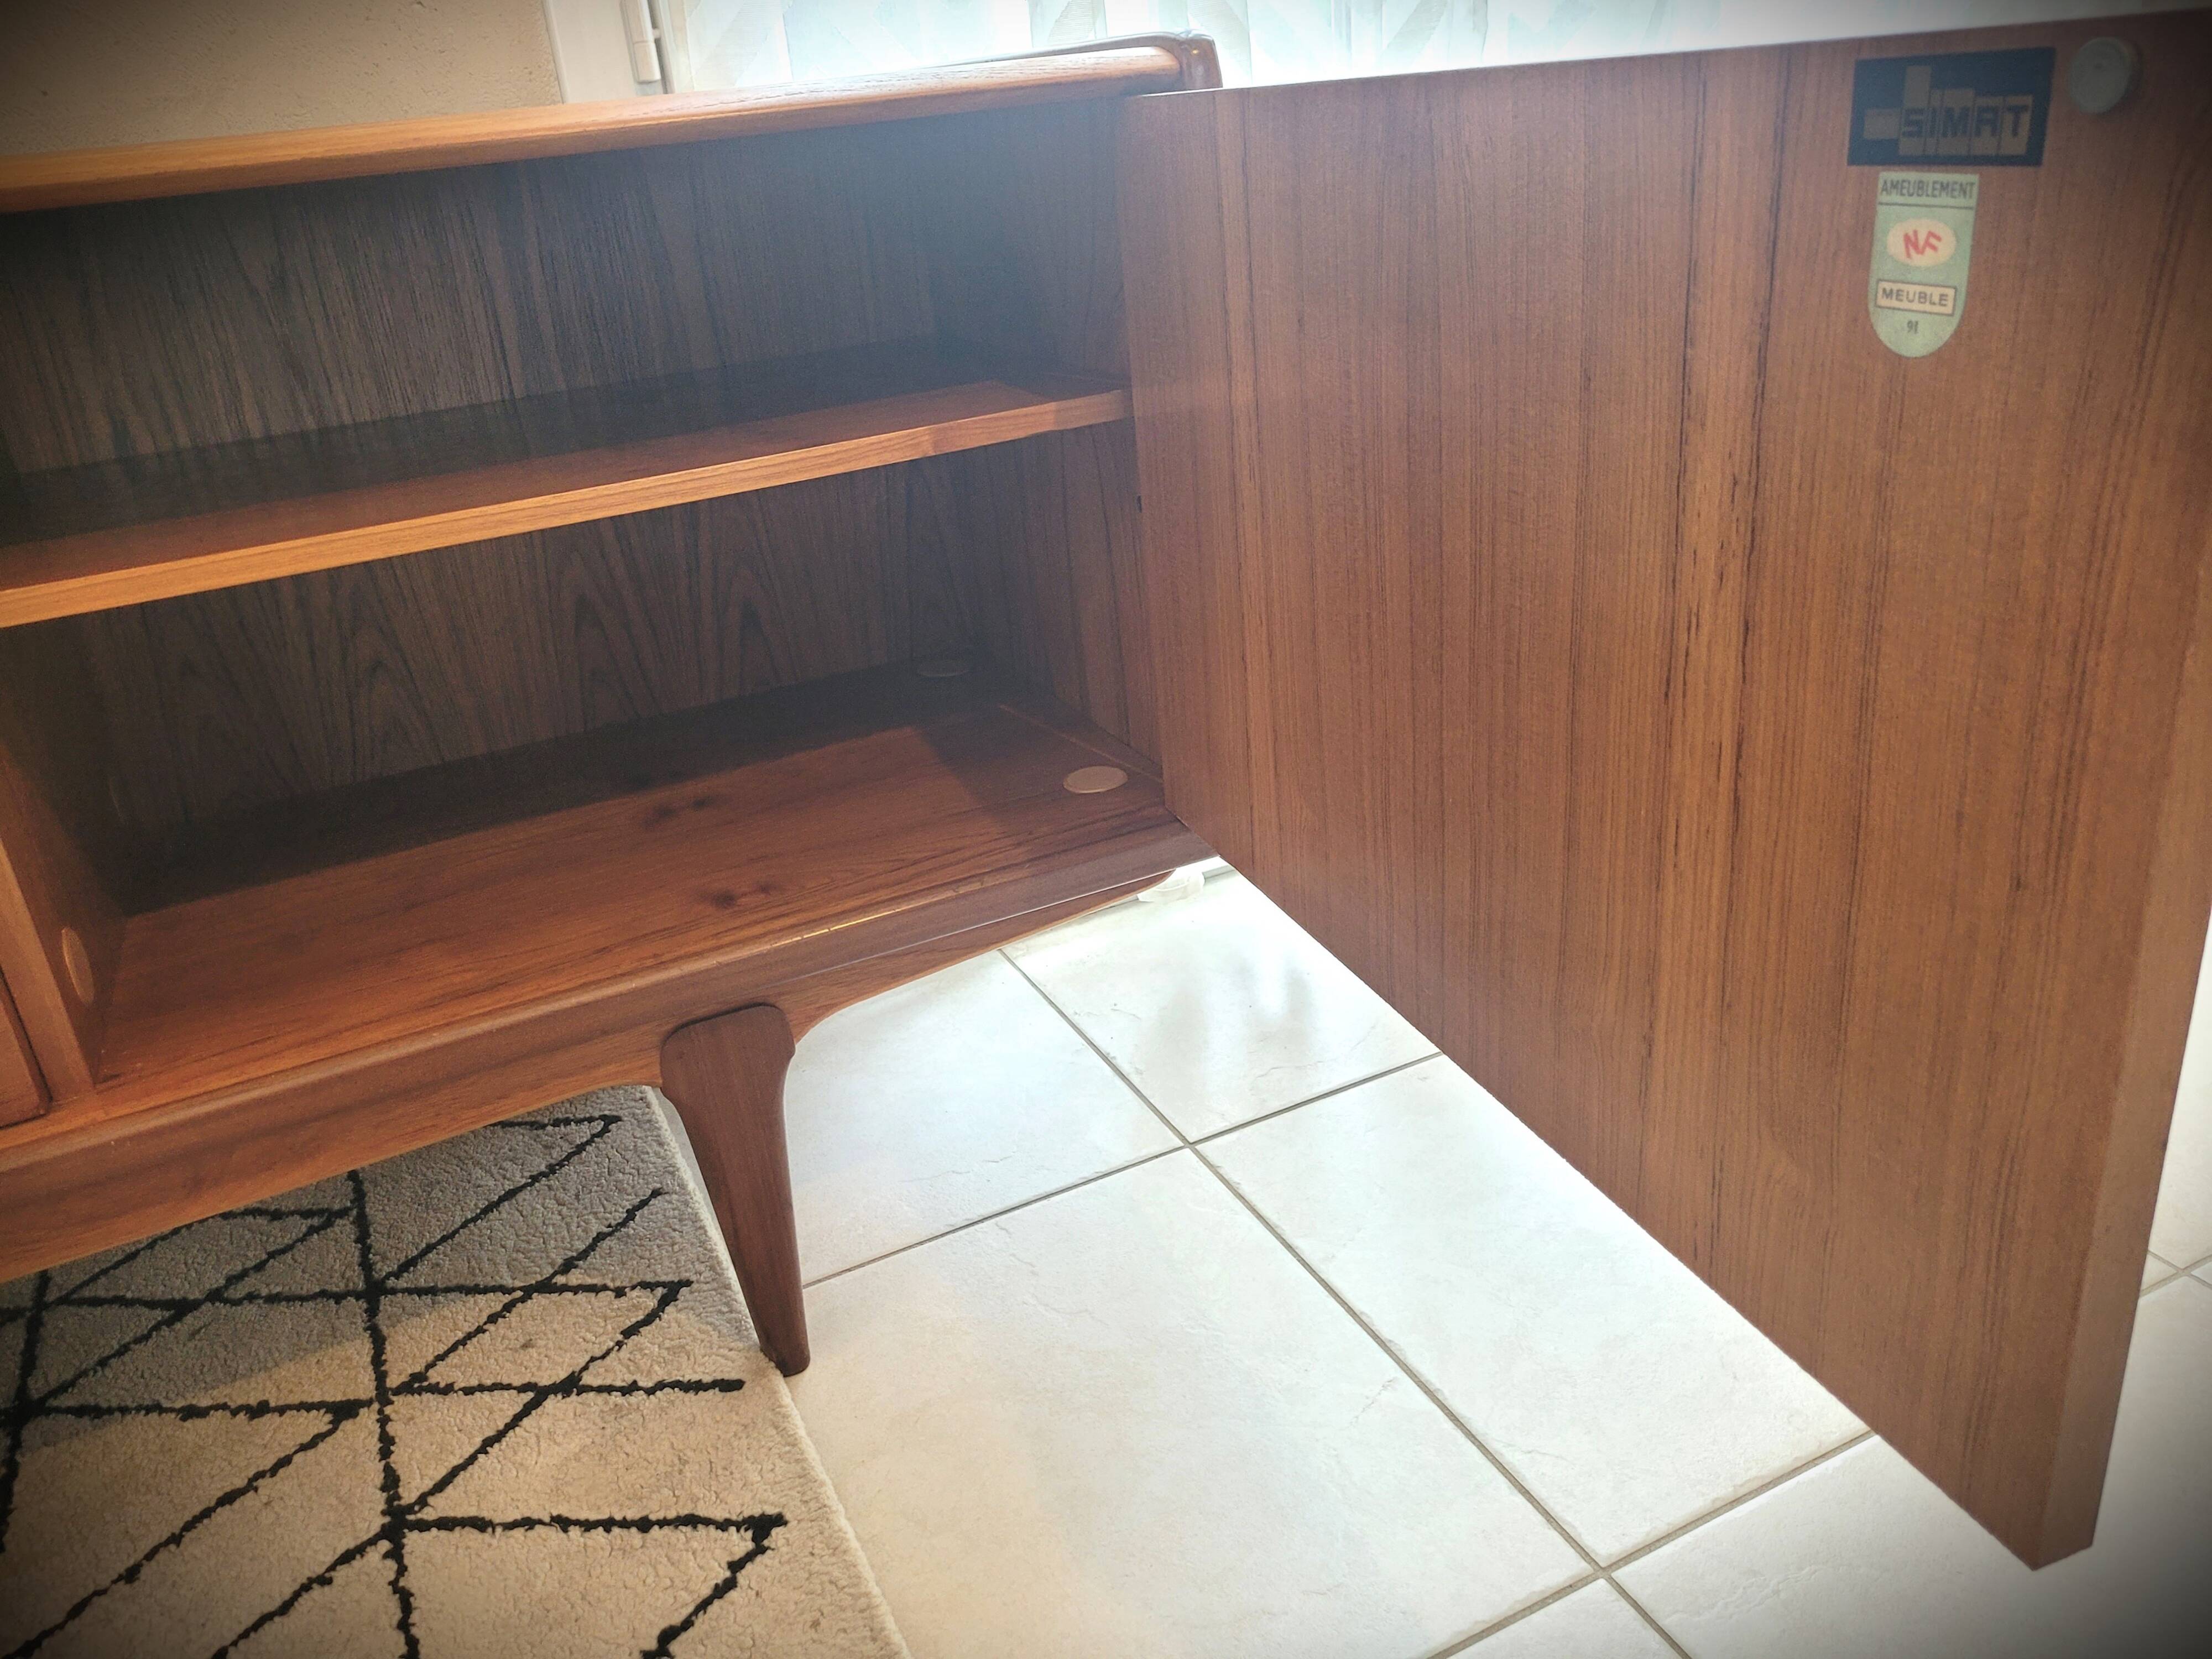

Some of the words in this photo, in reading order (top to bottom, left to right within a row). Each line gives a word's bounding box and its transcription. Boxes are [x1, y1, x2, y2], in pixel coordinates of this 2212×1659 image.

[1901, 104, 2030, 138] SIMAT
[1881, 179, 1976, 199] AMEUBLEMENT
[1903, 229, 1943, 259] NF
[1881, 288, 1948, 306] MEUBLE
